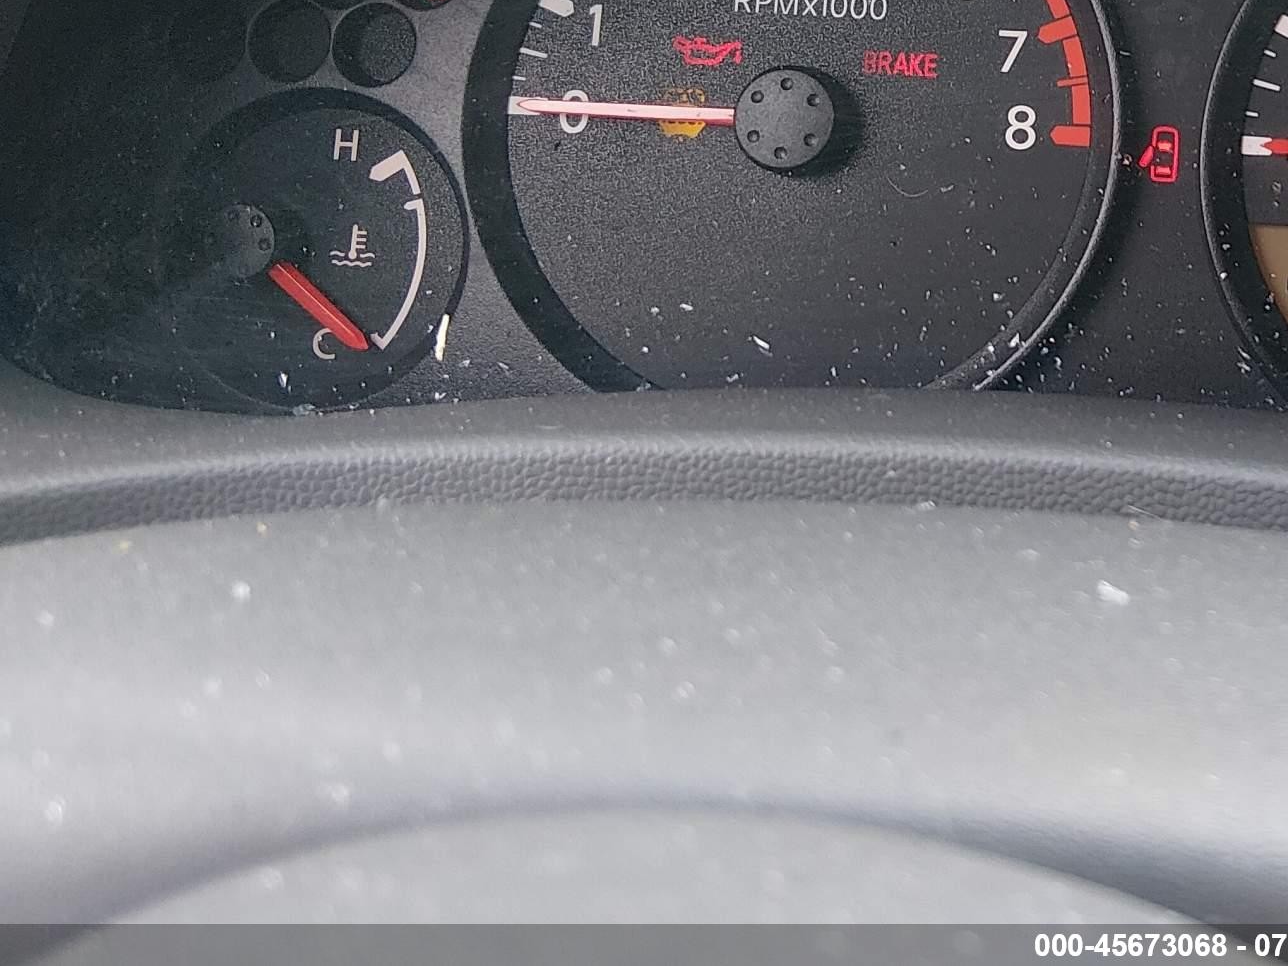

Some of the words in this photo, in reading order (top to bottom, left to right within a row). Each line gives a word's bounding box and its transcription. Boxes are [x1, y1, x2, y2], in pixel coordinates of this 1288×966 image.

[589, 4, 603, 46] 1
[863, 51, 939, 78] BRAKE
[998, 30, 1028, 73] 7
[559, 90, 590, 134] 0
[1005, 105, 1037, 149] 8
[333, 129, 360, 162] H
[312, 328, 336, 360] C
